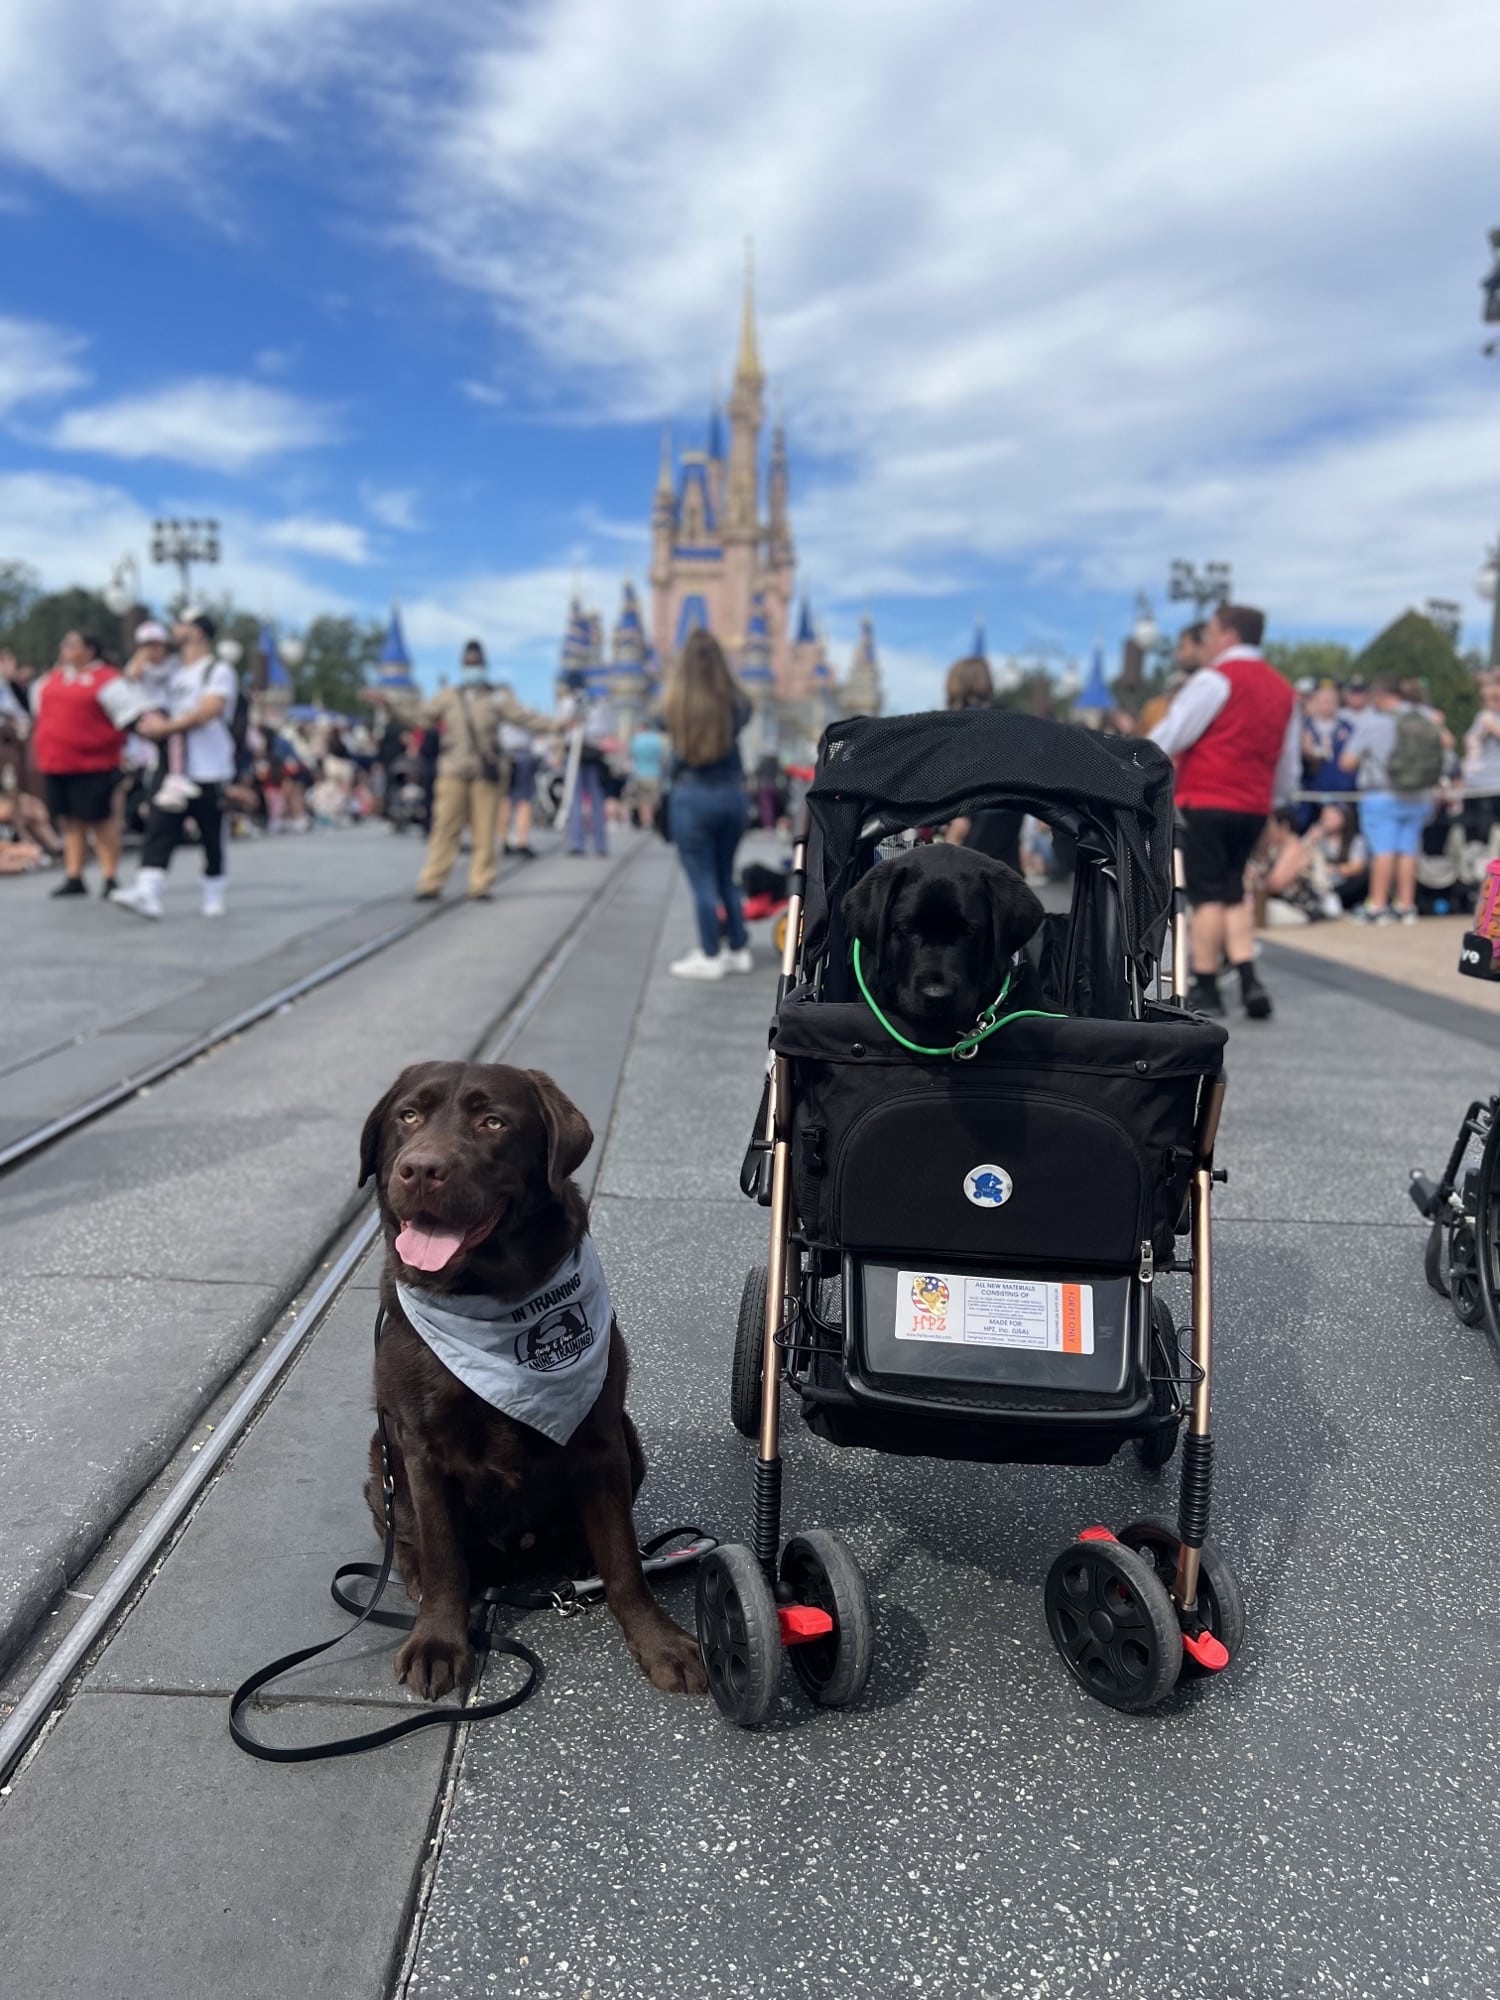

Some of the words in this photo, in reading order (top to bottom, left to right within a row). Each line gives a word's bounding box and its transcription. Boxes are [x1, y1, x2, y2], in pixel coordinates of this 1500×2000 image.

[511, 1307, 527, 1323] IN
[528, 1272, 581, 1315] TRAINING
[981, 1289, 1020, 1298] CONSISTING
[1067, 1292, 1075, 1306] FOR
[912, 1315, 946, 1332] HPZ
[1011, 1328, 1029, 1336] (USA)
[1068, 1323, 1076, 1343] ONLY
[528, 1353, 556, 1370] ANINE
[556, 1333, 591, 1360] TRAINING
